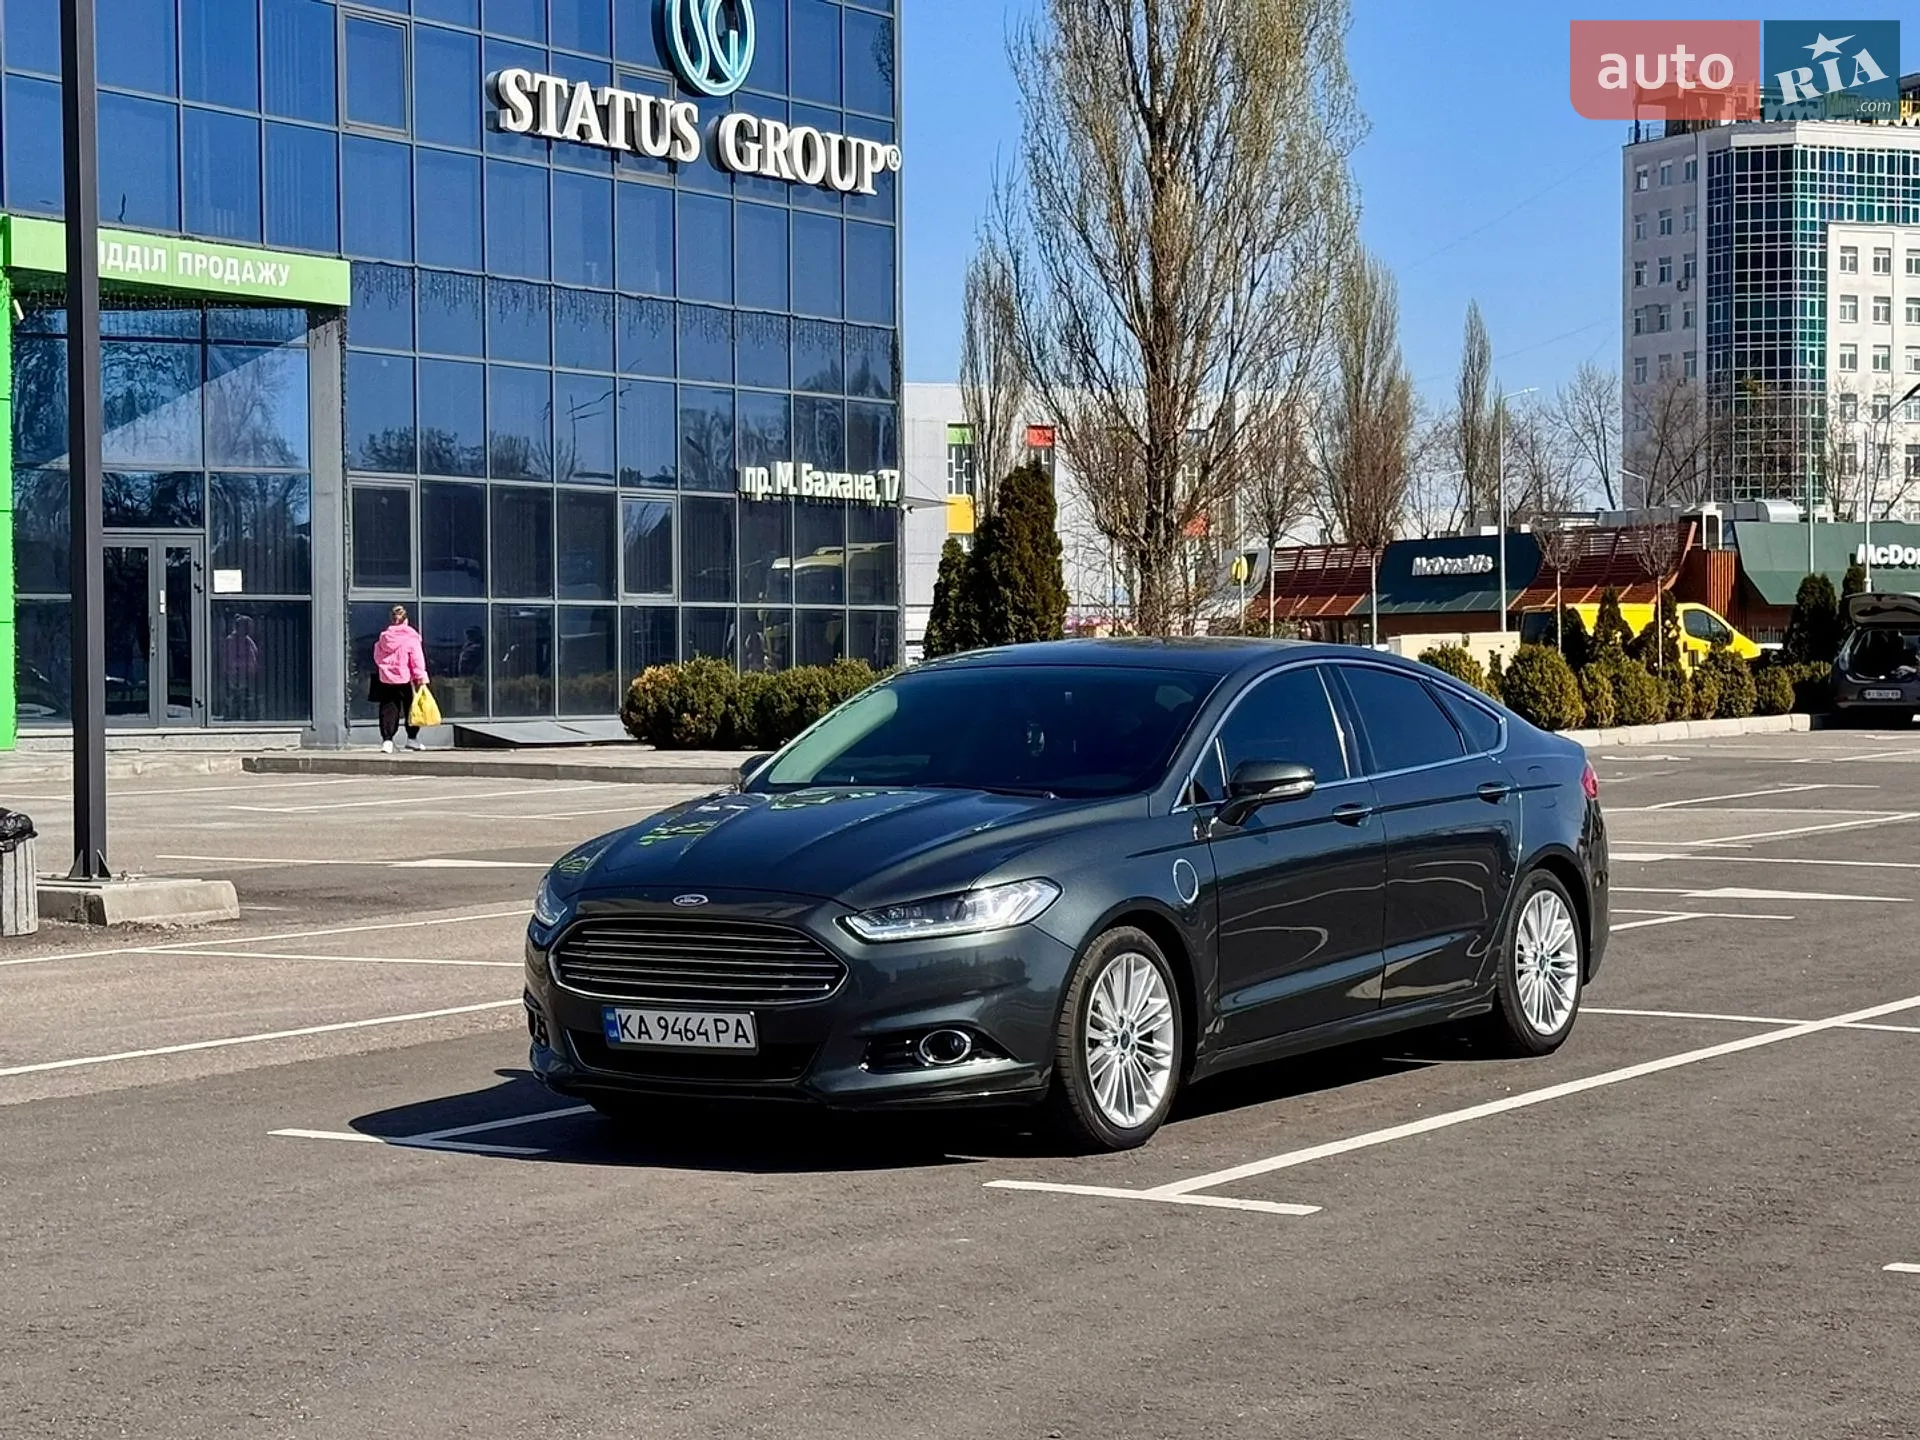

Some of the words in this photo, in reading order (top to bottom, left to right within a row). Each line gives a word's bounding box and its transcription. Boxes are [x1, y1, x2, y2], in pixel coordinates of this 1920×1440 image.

[496, 68, 700, 163] STATUS
[98, 240, 167, 274] ІДДІЛ
[178, 251, 290, 288] ПРОДАЖУ
[877, 469, 900, 501] 17
[1856, 543, 1920, 565] McDo
